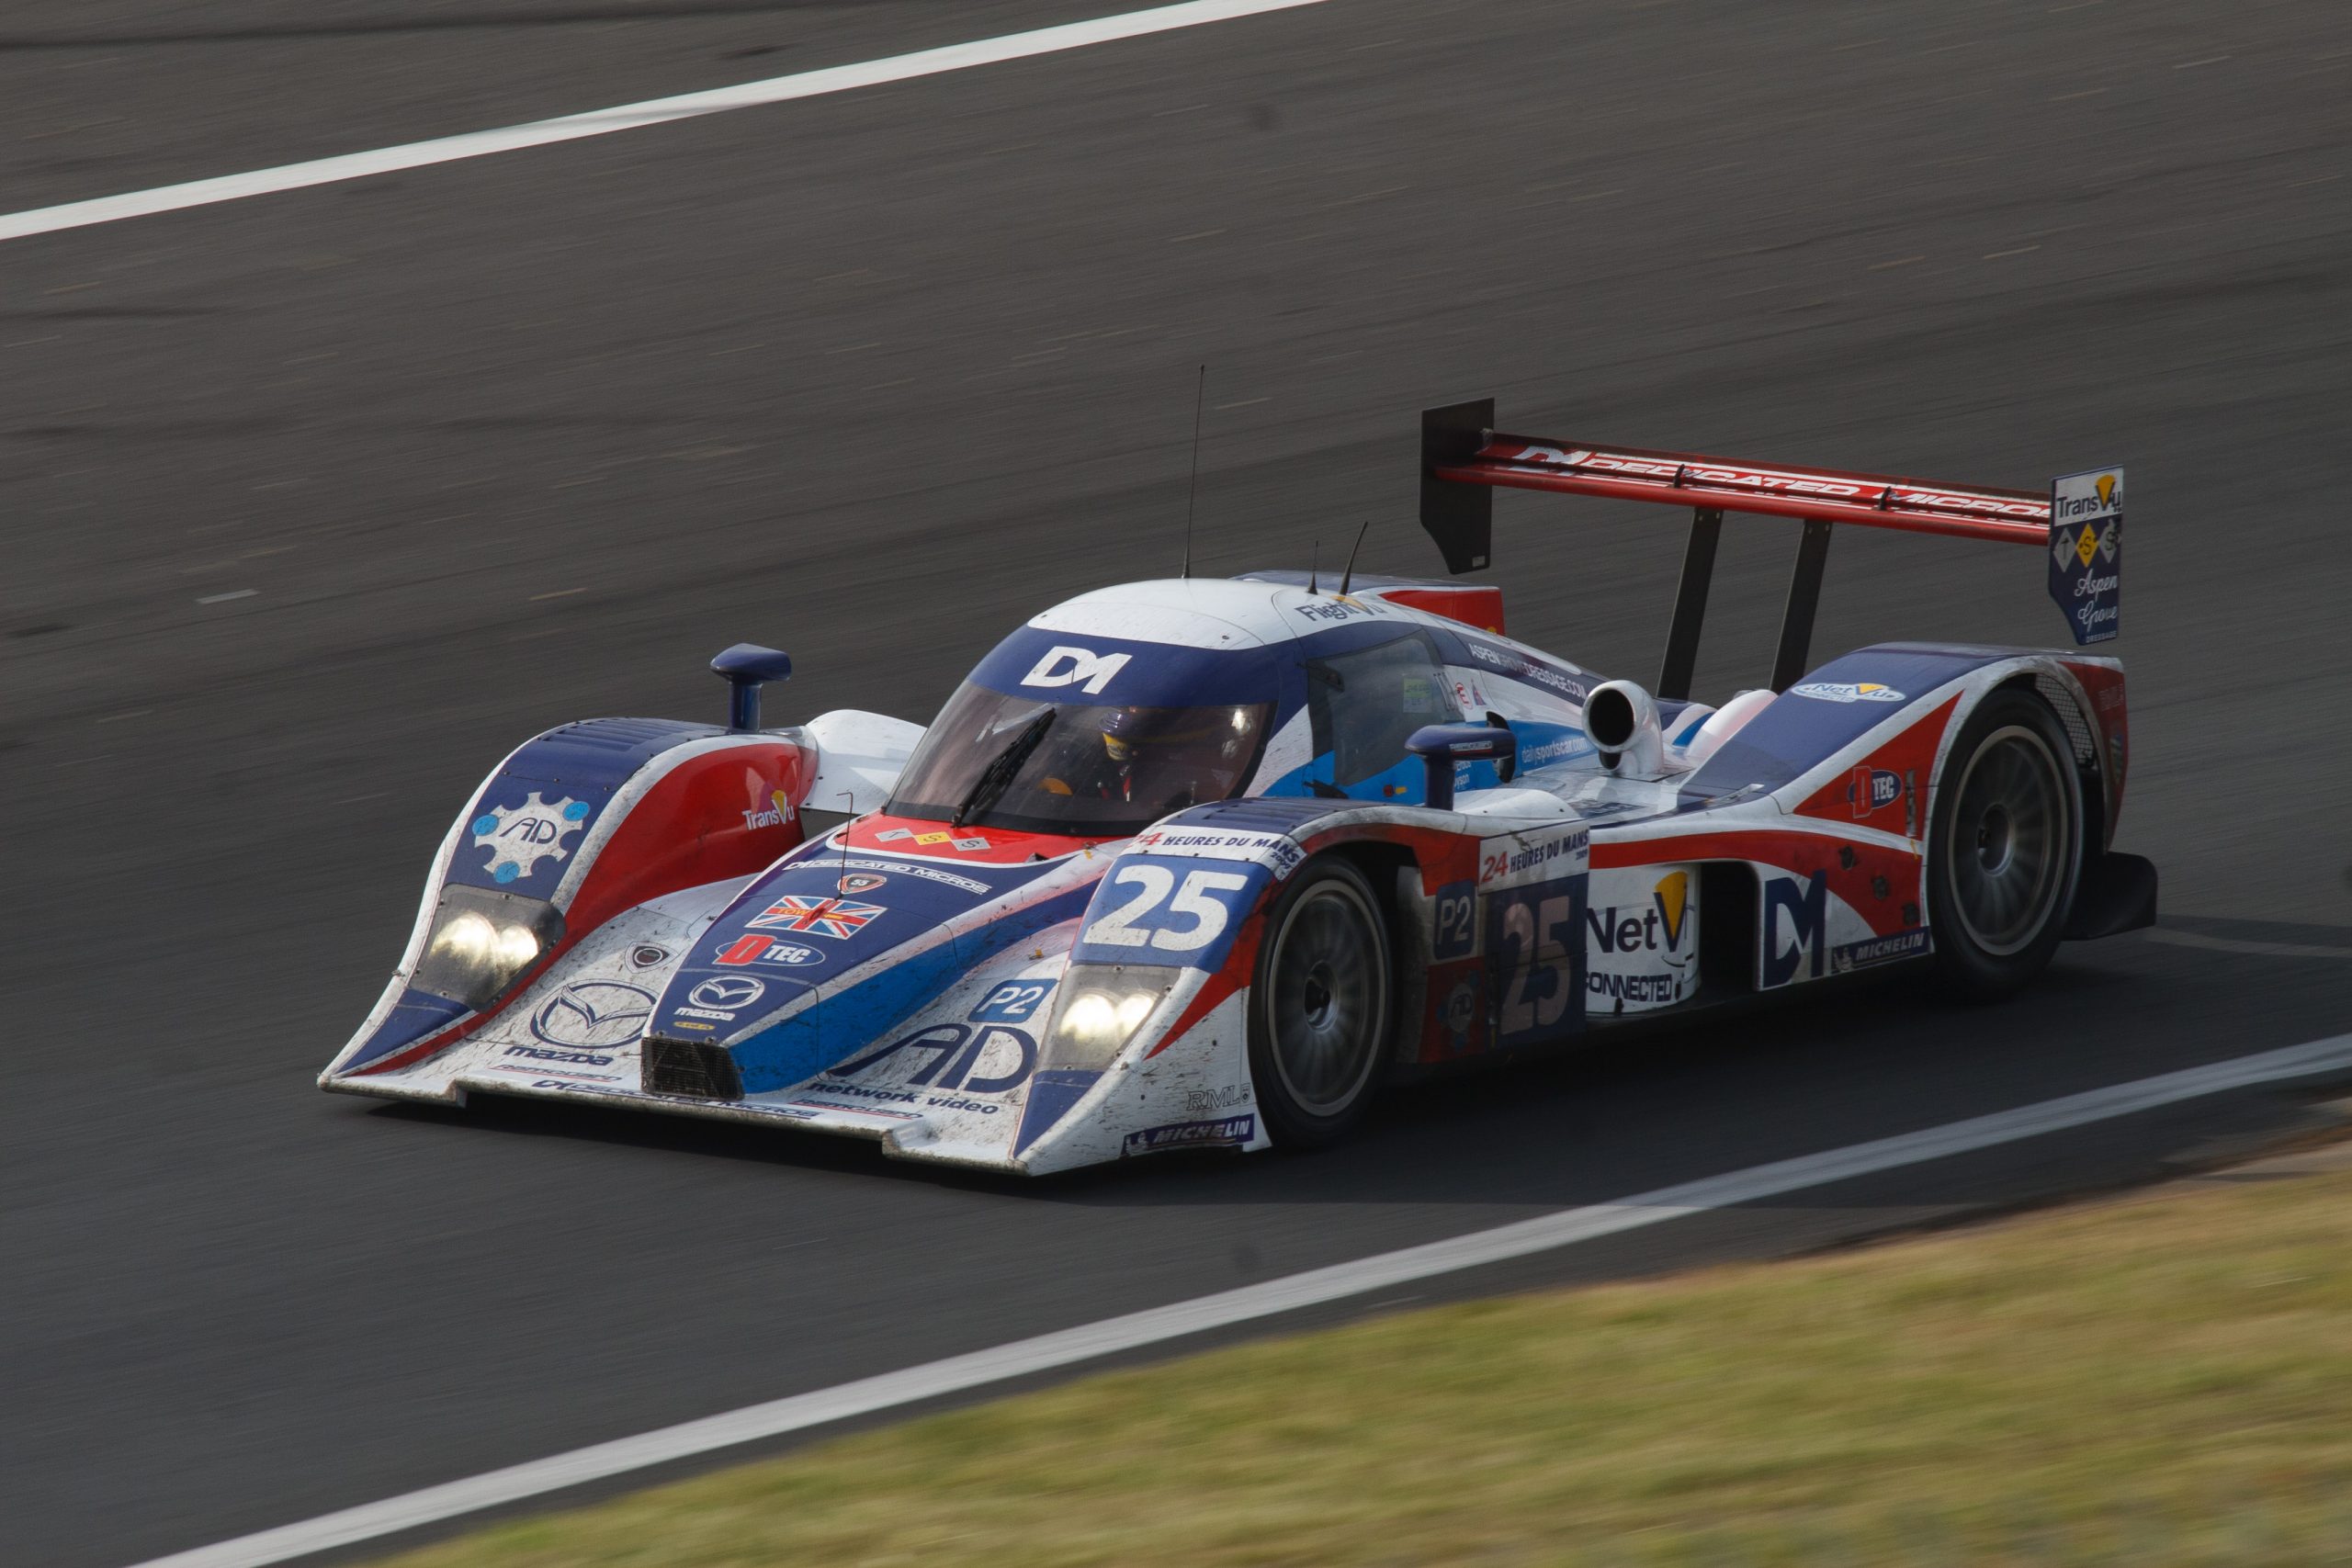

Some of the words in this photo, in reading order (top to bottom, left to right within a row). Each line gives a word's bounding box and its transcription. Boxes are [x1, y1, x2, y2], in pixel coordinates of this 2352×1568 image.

[1579, 458, 1860, 497] DEDICATED
[2056, 475, 2121, 519] TransVu
[2075, 569, 2118, 602] Aspen
[742, 790, 795, 830] TransVu
[499, 817, 557, 844] AD
[1162, 837, 1223, 847] HEURES
[1224, 837, 1250, 847] DU
[1251, 839, 1301, 863] MANS
[1480, 852, 1509, 885] 24
[1510, 846, 1544, 874] HEURES
[1547, 842, 1560, 861] DU
[1562, 829, 1589, 854] MANS
[808, 860, 911, 873] DEDICATED
[914, 869, 990, 895] MICROS
[1082, 865, 1249, 952] 25
[1437, 896, 1472, 944] P2
[1856, 931, 1925, 961] MICHELIN
[1500, 896, 1572, 1035] 25
[976, 986, 1044, 1014] P2
[827, 1023, 1038, 1093] AD
[805, 1082, 919, 1103] network
[926, 1093, 1000, 1114] video
[1186, 1085, 1240, 1111] RML
[1154, 1120, 1250, 1144] MICHELIN
